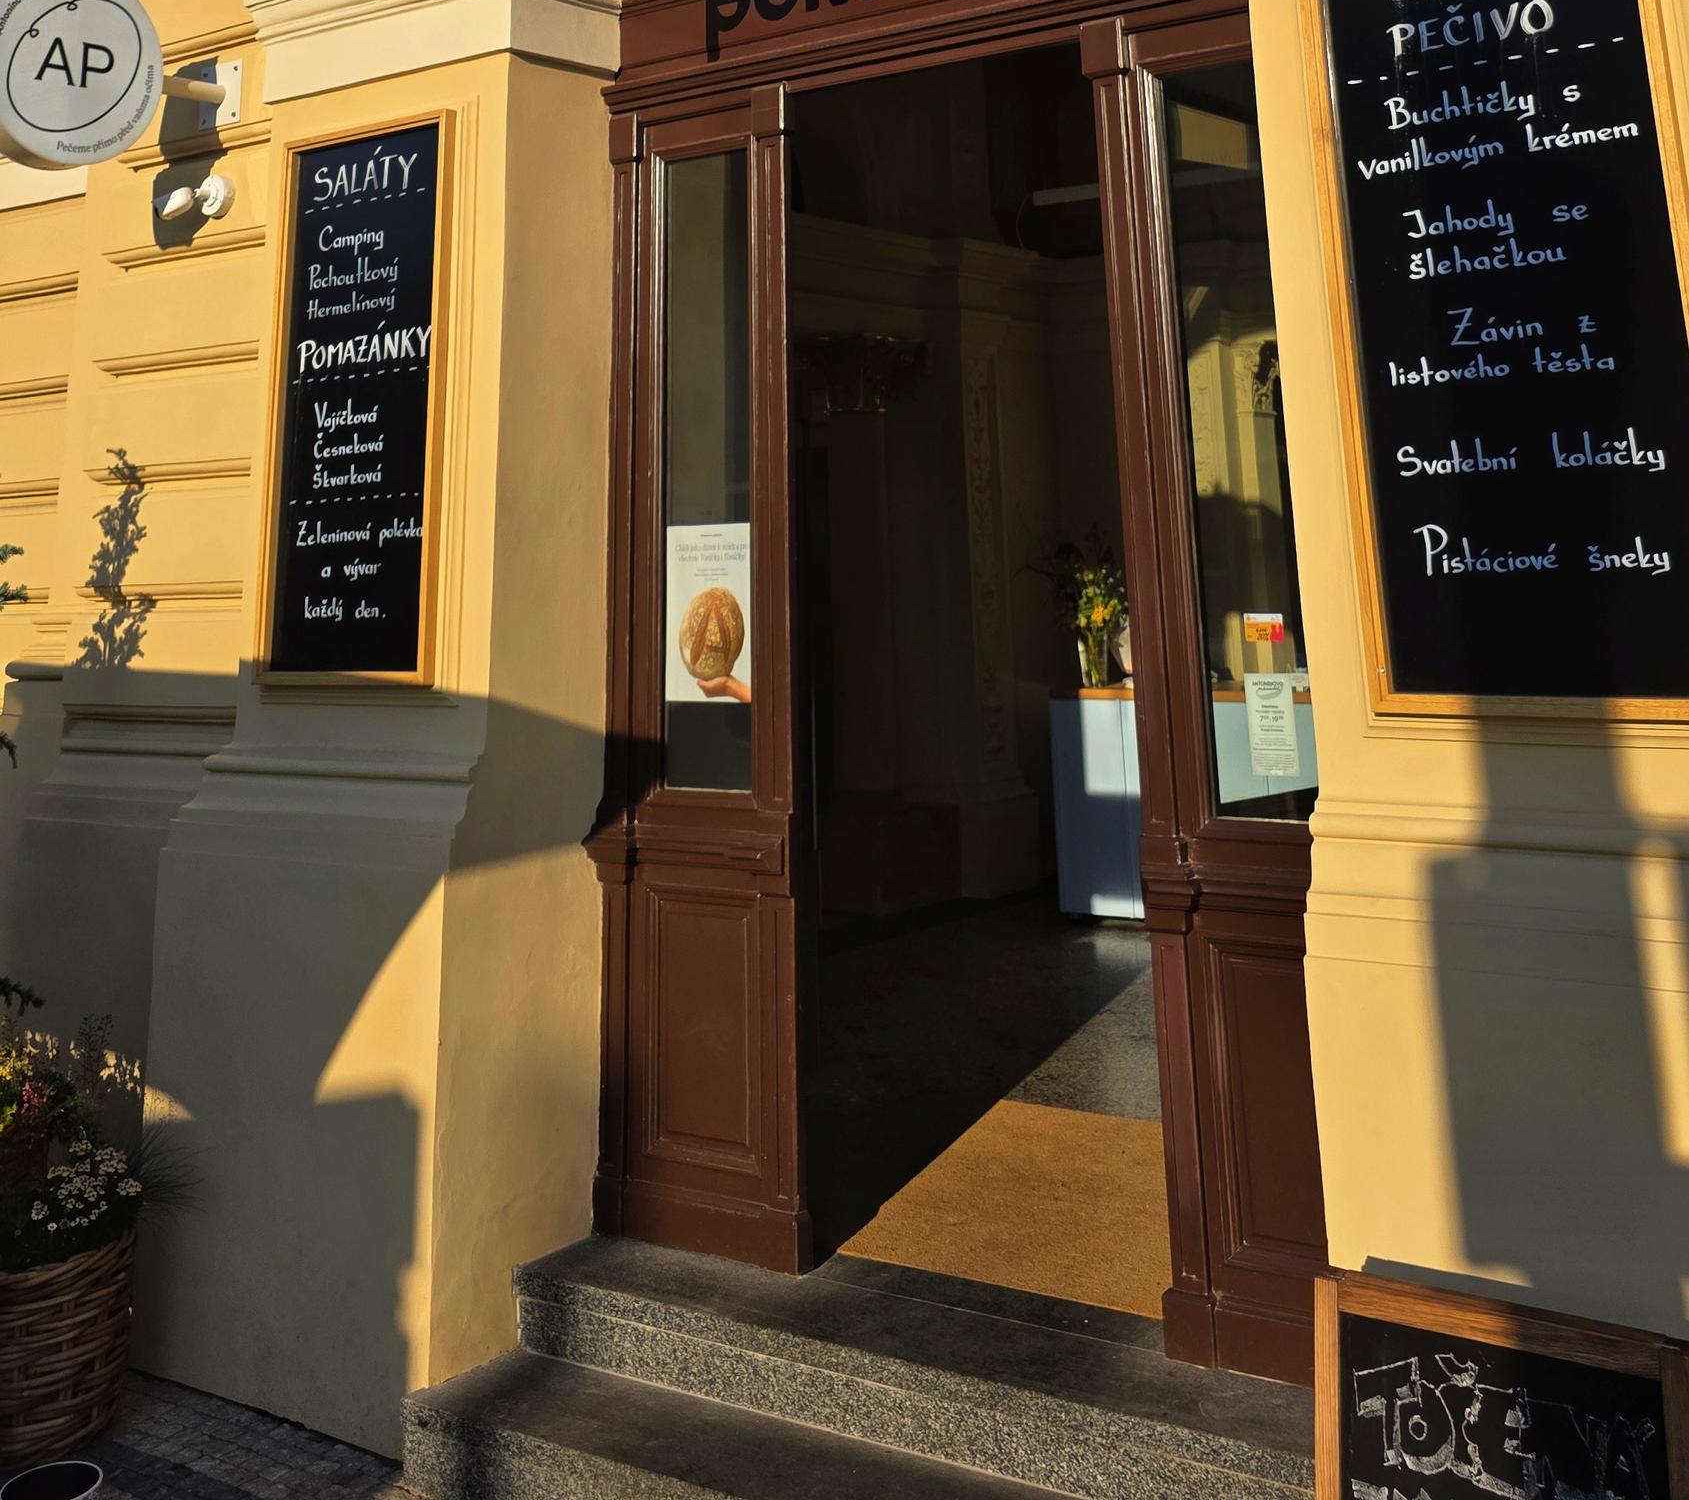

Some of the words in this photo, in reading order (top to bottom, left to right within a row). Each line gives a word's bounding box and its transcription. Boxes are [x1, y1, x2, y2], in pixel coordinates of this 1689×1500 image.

[34, 37, 115, 88] AP
[1383, 81, 1535, 130] Buchtičky
[1562, 84, 1582, 103] s
[1527, 122, 1640, 153] krémem
[313, 145, 418, 202] SALÁTY
[1402, 199, 1515, 239] Jahody
[1552, 204, 1590, 224] se
[318, 225, 385, 256] Camping
[308, 257, 399, 291] Pochoutkový
[307, 287, 396, 320] Hermelínový
[1447, 307, 1544, 347] Závin
[1578, 315, 1598, 334] z
[297, 320, 432, 374] POMAZÁNKY
[1389, 353, 1510, 387] listového
[1532, 343, 1616, 374] těsta
[314, 398, 379, 434] Vajíčková
[313, 431, 385, 460] Česneková
[1397, 437, 1518, 478] Svatební
[1552, 427, 1667, 473] koláčky
[312, 464, 382, 490] Škvarková
[295, 519, 372, 547] Zeleninová
[1413, 523, 1560, 577] Pistáciové
[1588, 535, 1671, 577] šneky
[321, 564, 332, 579] a
[343, 557, 382, 582] vývar
[304, 596, 344, 622] každý
